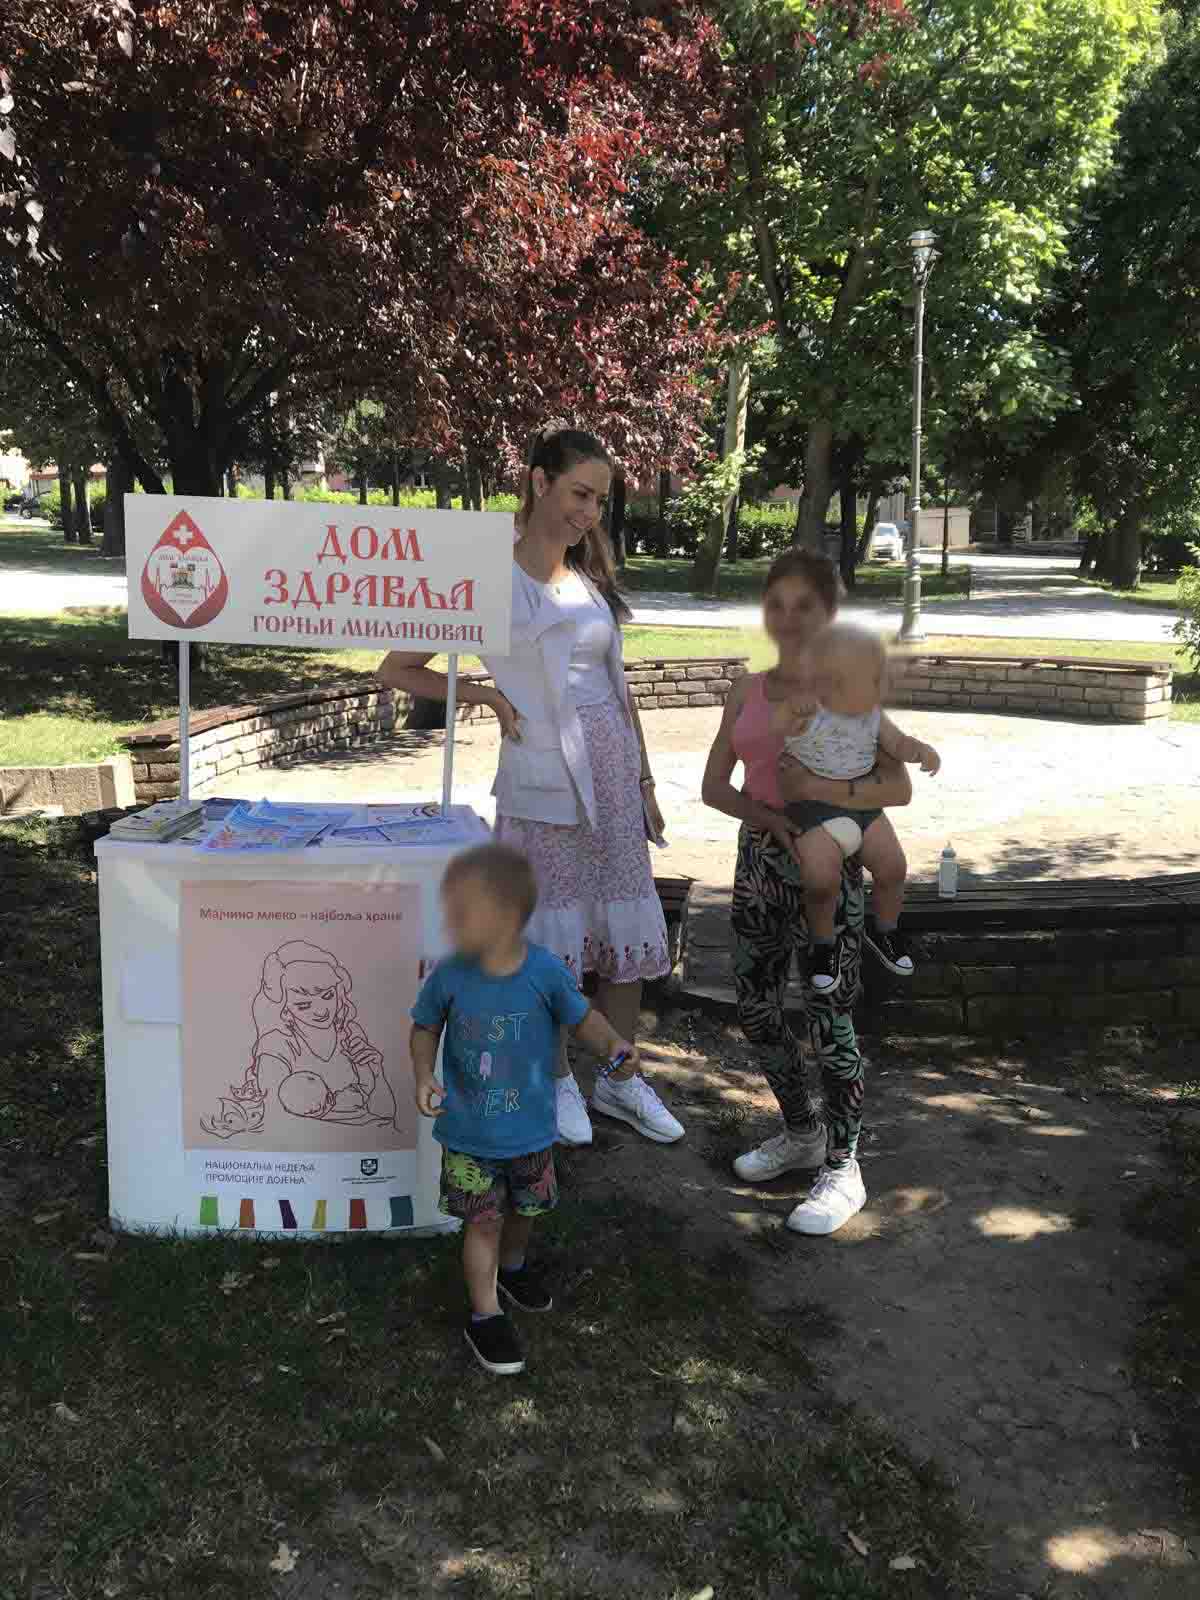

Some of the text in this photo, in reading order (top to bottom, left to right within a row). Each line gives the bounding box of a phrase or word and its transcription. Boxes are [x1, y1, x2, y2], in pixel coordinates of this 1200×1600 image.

[317, 524, 424, 565] ДОМ
[263, 568, 475, 612] ЗДРАВЉА
[253, 614, 484, 646] ГОРЊИ МИЛАНОВАЦ
[205, 1161, 272, 1172] НАЦИОНАЛНА
[205, 1173, 264, 1184] ПРОМОЦИЈЕ
